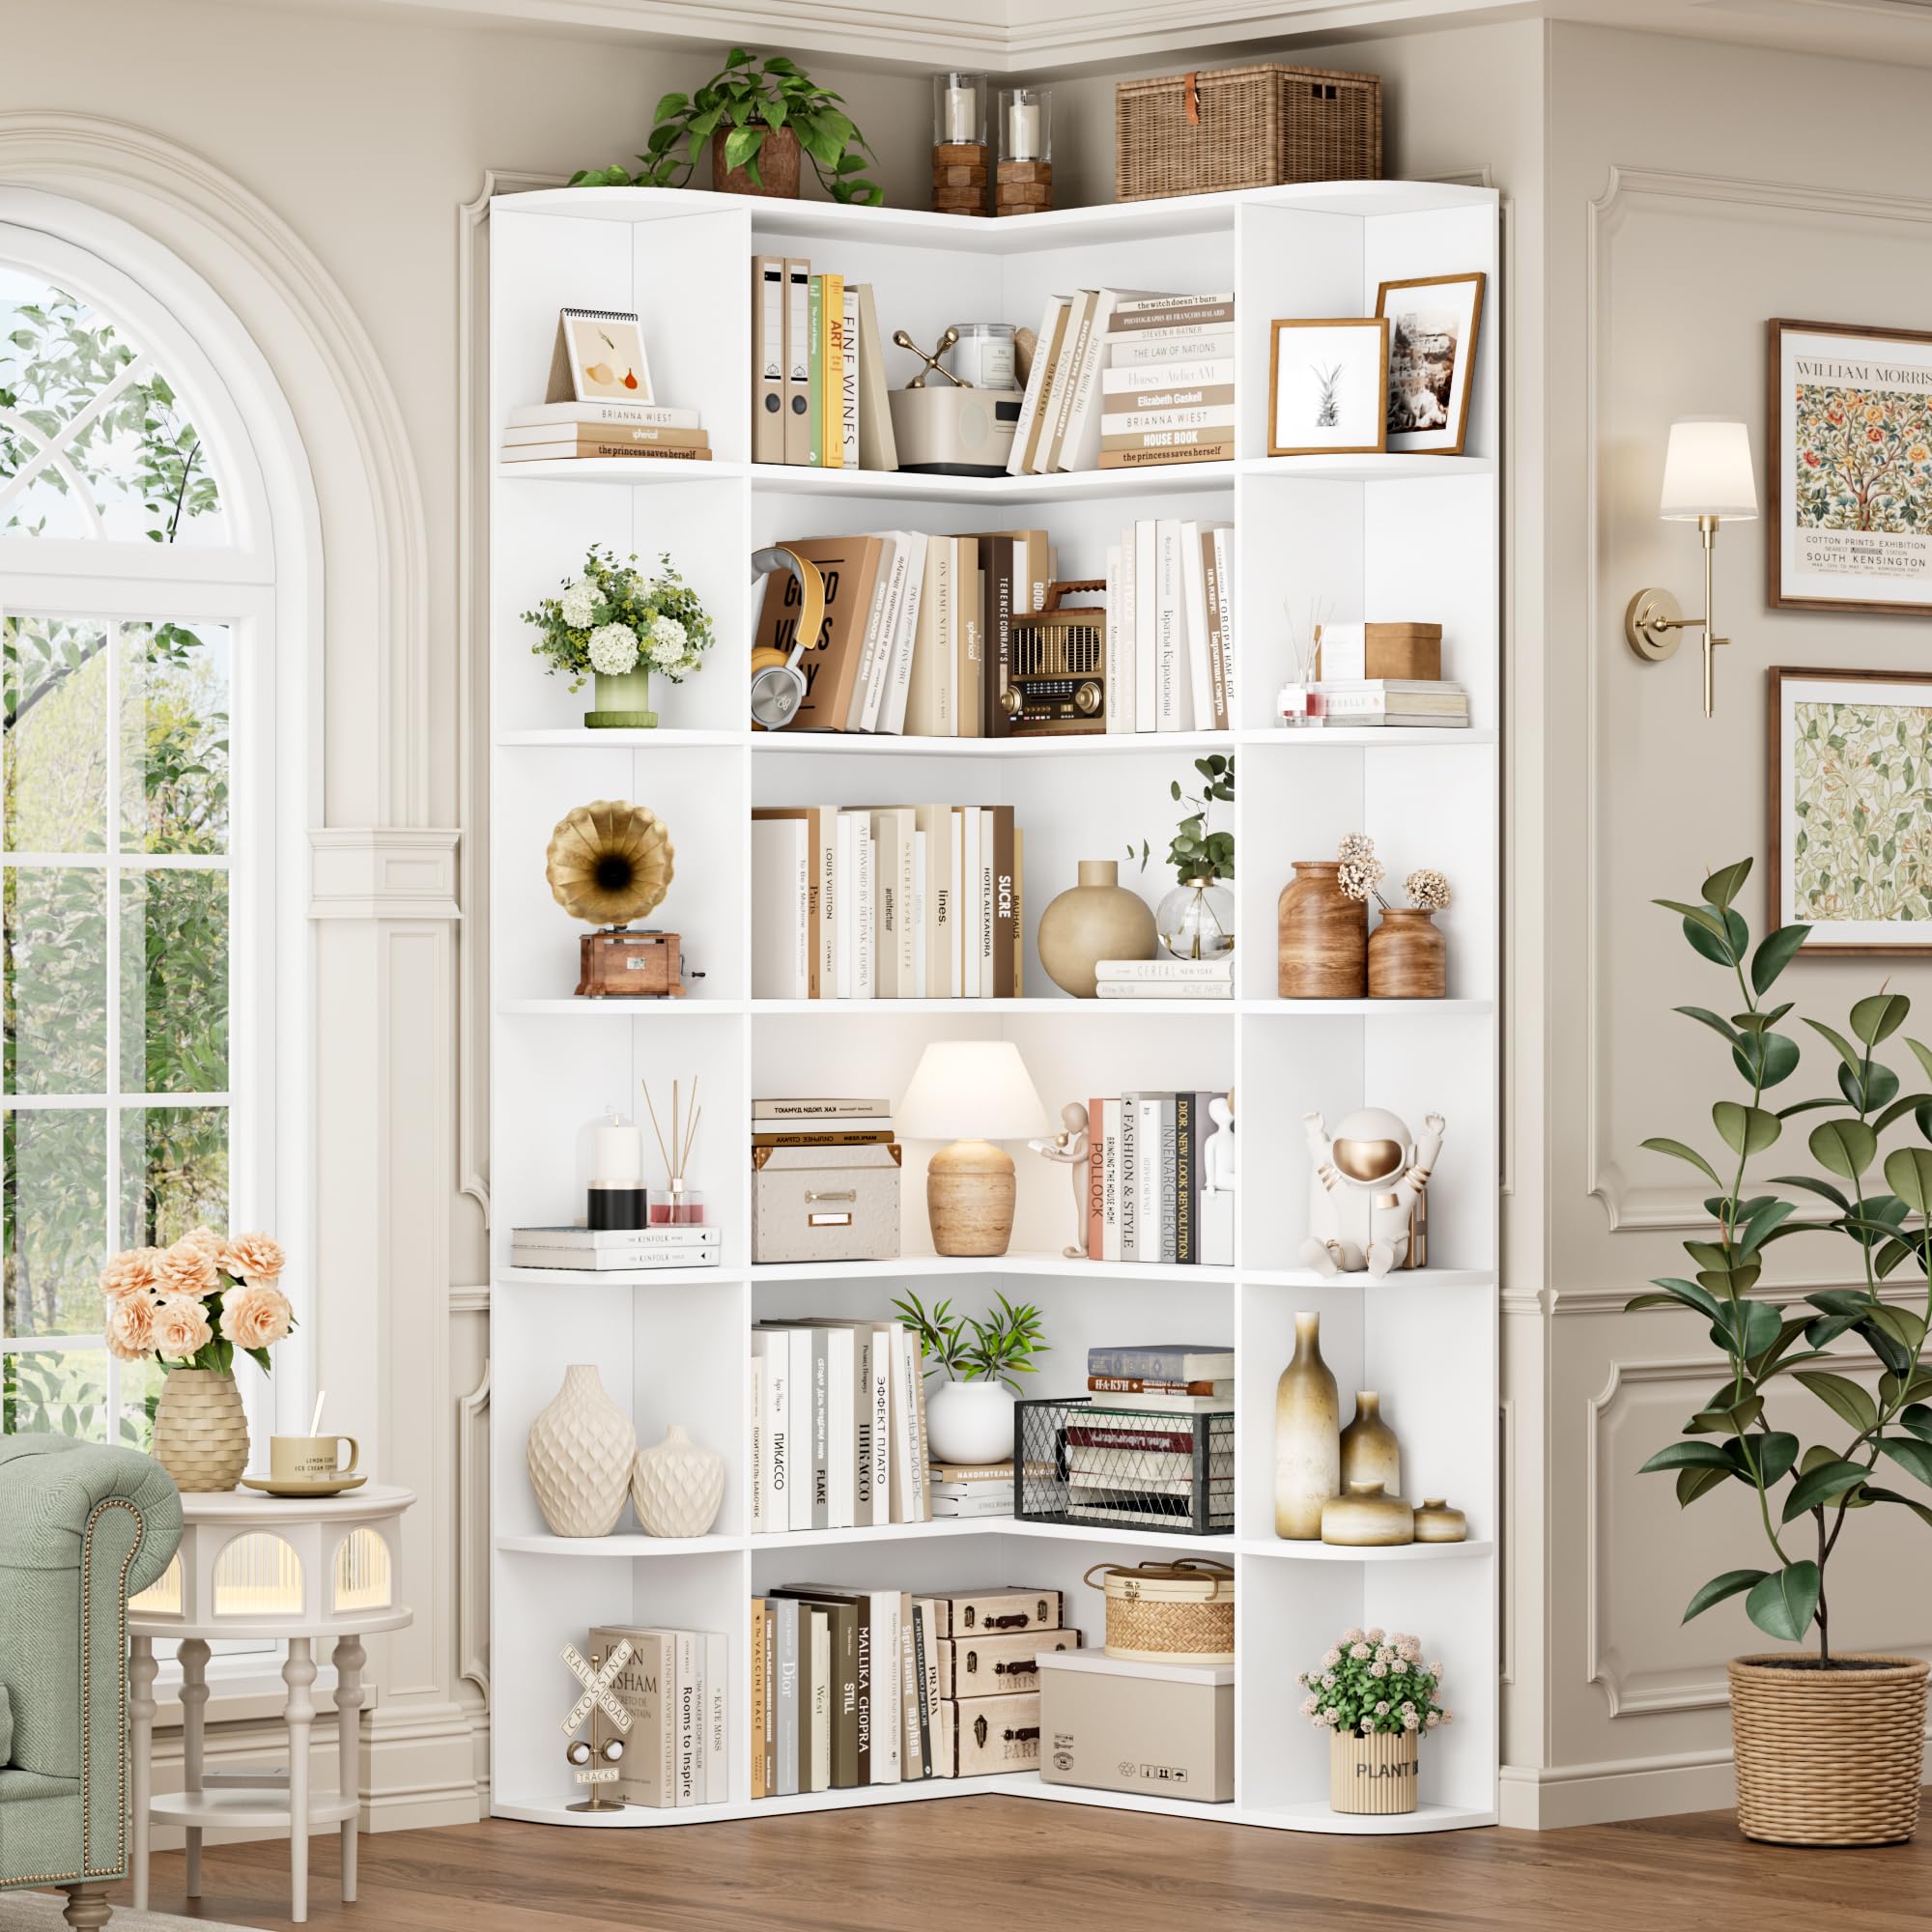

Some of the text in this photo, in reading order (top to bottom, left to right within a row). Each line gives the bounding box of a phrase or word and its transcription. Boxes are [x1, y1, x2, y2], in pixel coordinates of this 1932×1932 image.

[1150, 299, 1171, 308] witch
[1171, 298, 1199, 306] doesn't
[831, 320, 842, 350] ART
[1134, 343, 1216, 358] THE LAW OF NATIONS
[1796, 361, 1868, 381] WILLIAM
[602, 410, 672, 422] BRIANNA WIEST
[1138, 391, 1203, 407] Elizabeth Gaskell
[1126, 412, 1208, 428] BRIANNA WIEST
[1144, 430, 1199, 447] HOUSE BOOK
[1805, 535, 1926, 550] COTTON PRINTS EXHIBITION
[1806, 553, 1926, 568] SOUTH KENSINGTON
[783, 571, 839, 608] GD
[1033, 582, 1044, 610] GOOD
[878, 649, 887, 661] for
[884, 591, 898, 639] sustainable
[894, 555, 905, 590] lifestyle
[1000, 578, 1009, 663] TERENCE CONRAN'S
[1221, 598, 1231, 650] ГОВОРИ
[774, 617, 834, 652] VIS
[968, 621, 977, 661] spherical
[1161, 610, 1174, 717] Братья Карамазовы
[810, 886, 818, 915] Paris
[938, 890, 948, 926] lines.
[999, 875, 1010, 918] SUCRE
[1091, 1143, 1103, 1218] POLLOCK
[1123, 1114, 1134, 1249] FASHION & STYLE
[1163, 1124, 1176, 1258] INNENARCHITEKTUR
[1179, 1100, 1188, 1260] DIOR. NEW LOOK REVOLUTION
[877, 1377, 886, 1485] ЭФФЕКТ ПЛАТО
[774, 1433, 785, 1491] ПИКАССО
[859, 1424, 869, 1502] ПИКАССО
[816, 1469, 826, 1505] FLAKE
[566, 1650, 630, 1727] RAIL ROAD
[567, 1648, 628, 1729] CROSSING
[781, 1662, 796, 1698] Dior
[859, 1627, 869, 1753] MALLIKA CHOPRA
[902, 1625, 920, 1757] Sigrid Rausing mayhem
[929, 1666, 938, 1716] PRADA
[998, 1675, 1036, 1690] PARIS
[816, 1685, 825, 1715] West
[844, 1683, 855, 1715] STILL
[681, 1687, 692, 1798] Rooms to Inspire
[1003, 1743, 1038, 1761] PARI
[580, 1769, 616, 1783] TRACKS
